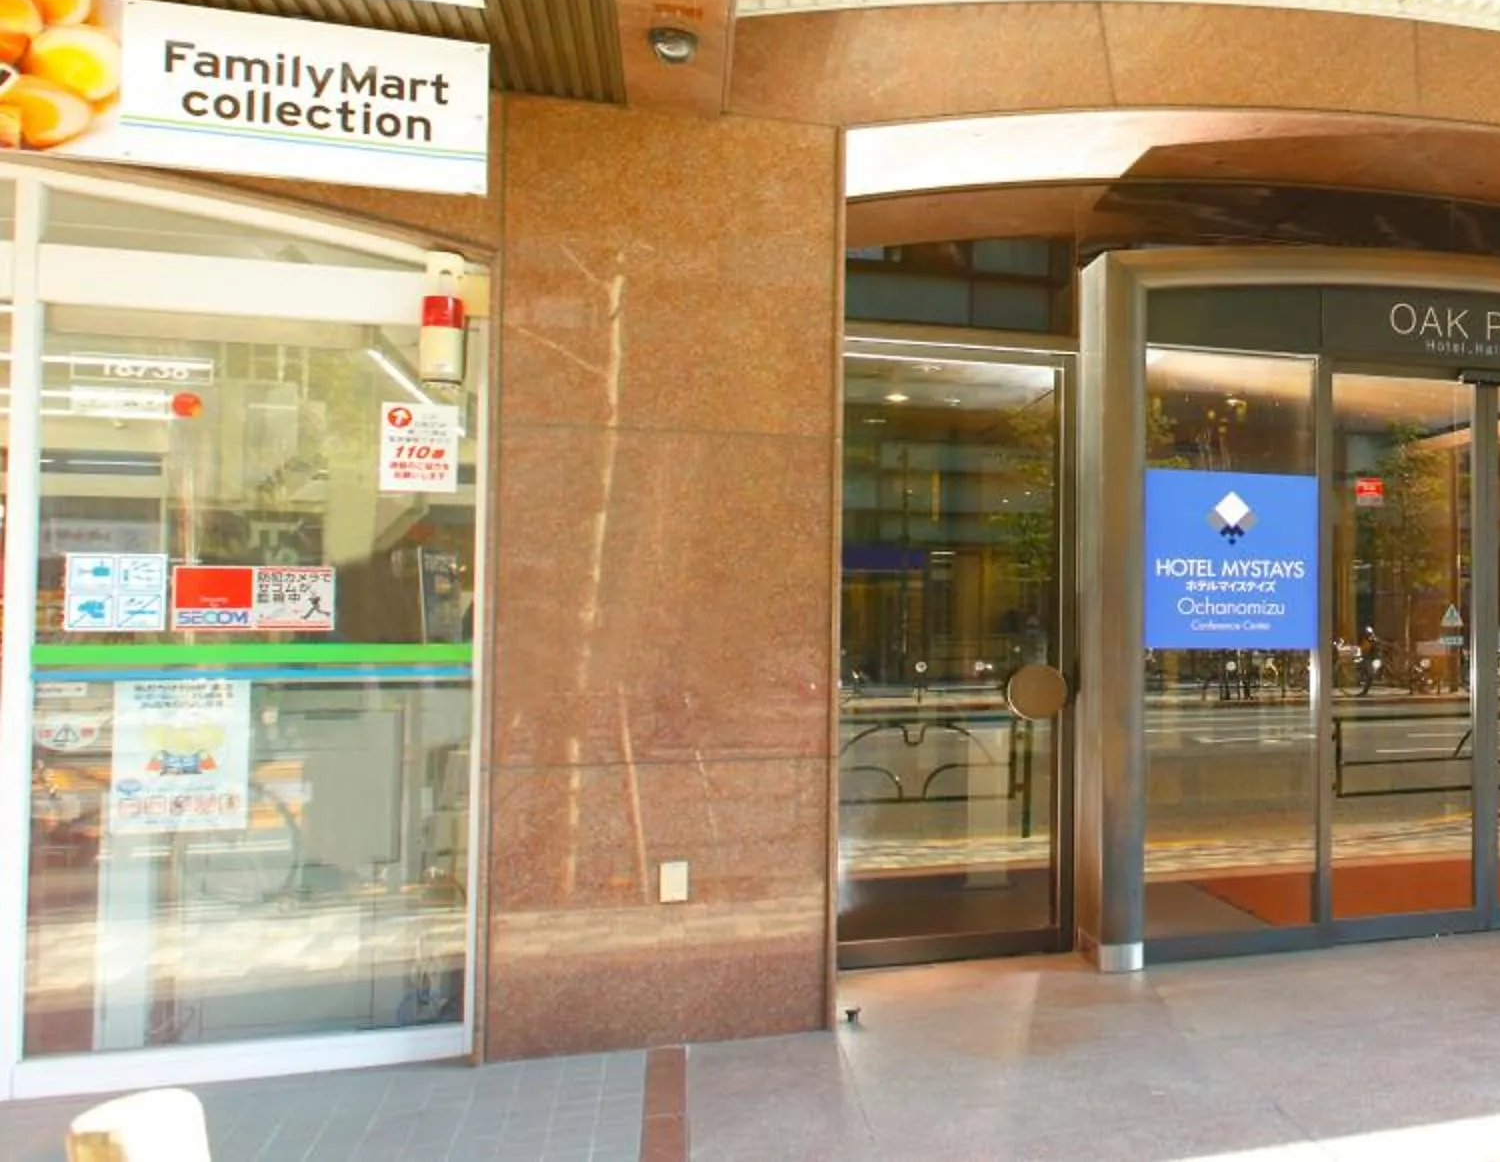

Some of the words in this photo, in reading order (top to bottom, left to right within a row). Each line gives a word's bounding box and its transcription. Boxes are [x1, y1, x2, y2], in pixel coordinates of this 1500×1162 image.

[163, 39, 450, 106] FamilyMart
[181, 88, 433, 142] collection
[1389, 302, 1469, 339] OAK
[1155, 559, 1216, 578] HOTEL
[1221, 560, 1306, 579] MYSTAYS
[178, 610, 249, 625] SECOM
[1177, 597, 1286, 615] Ochanomizu
